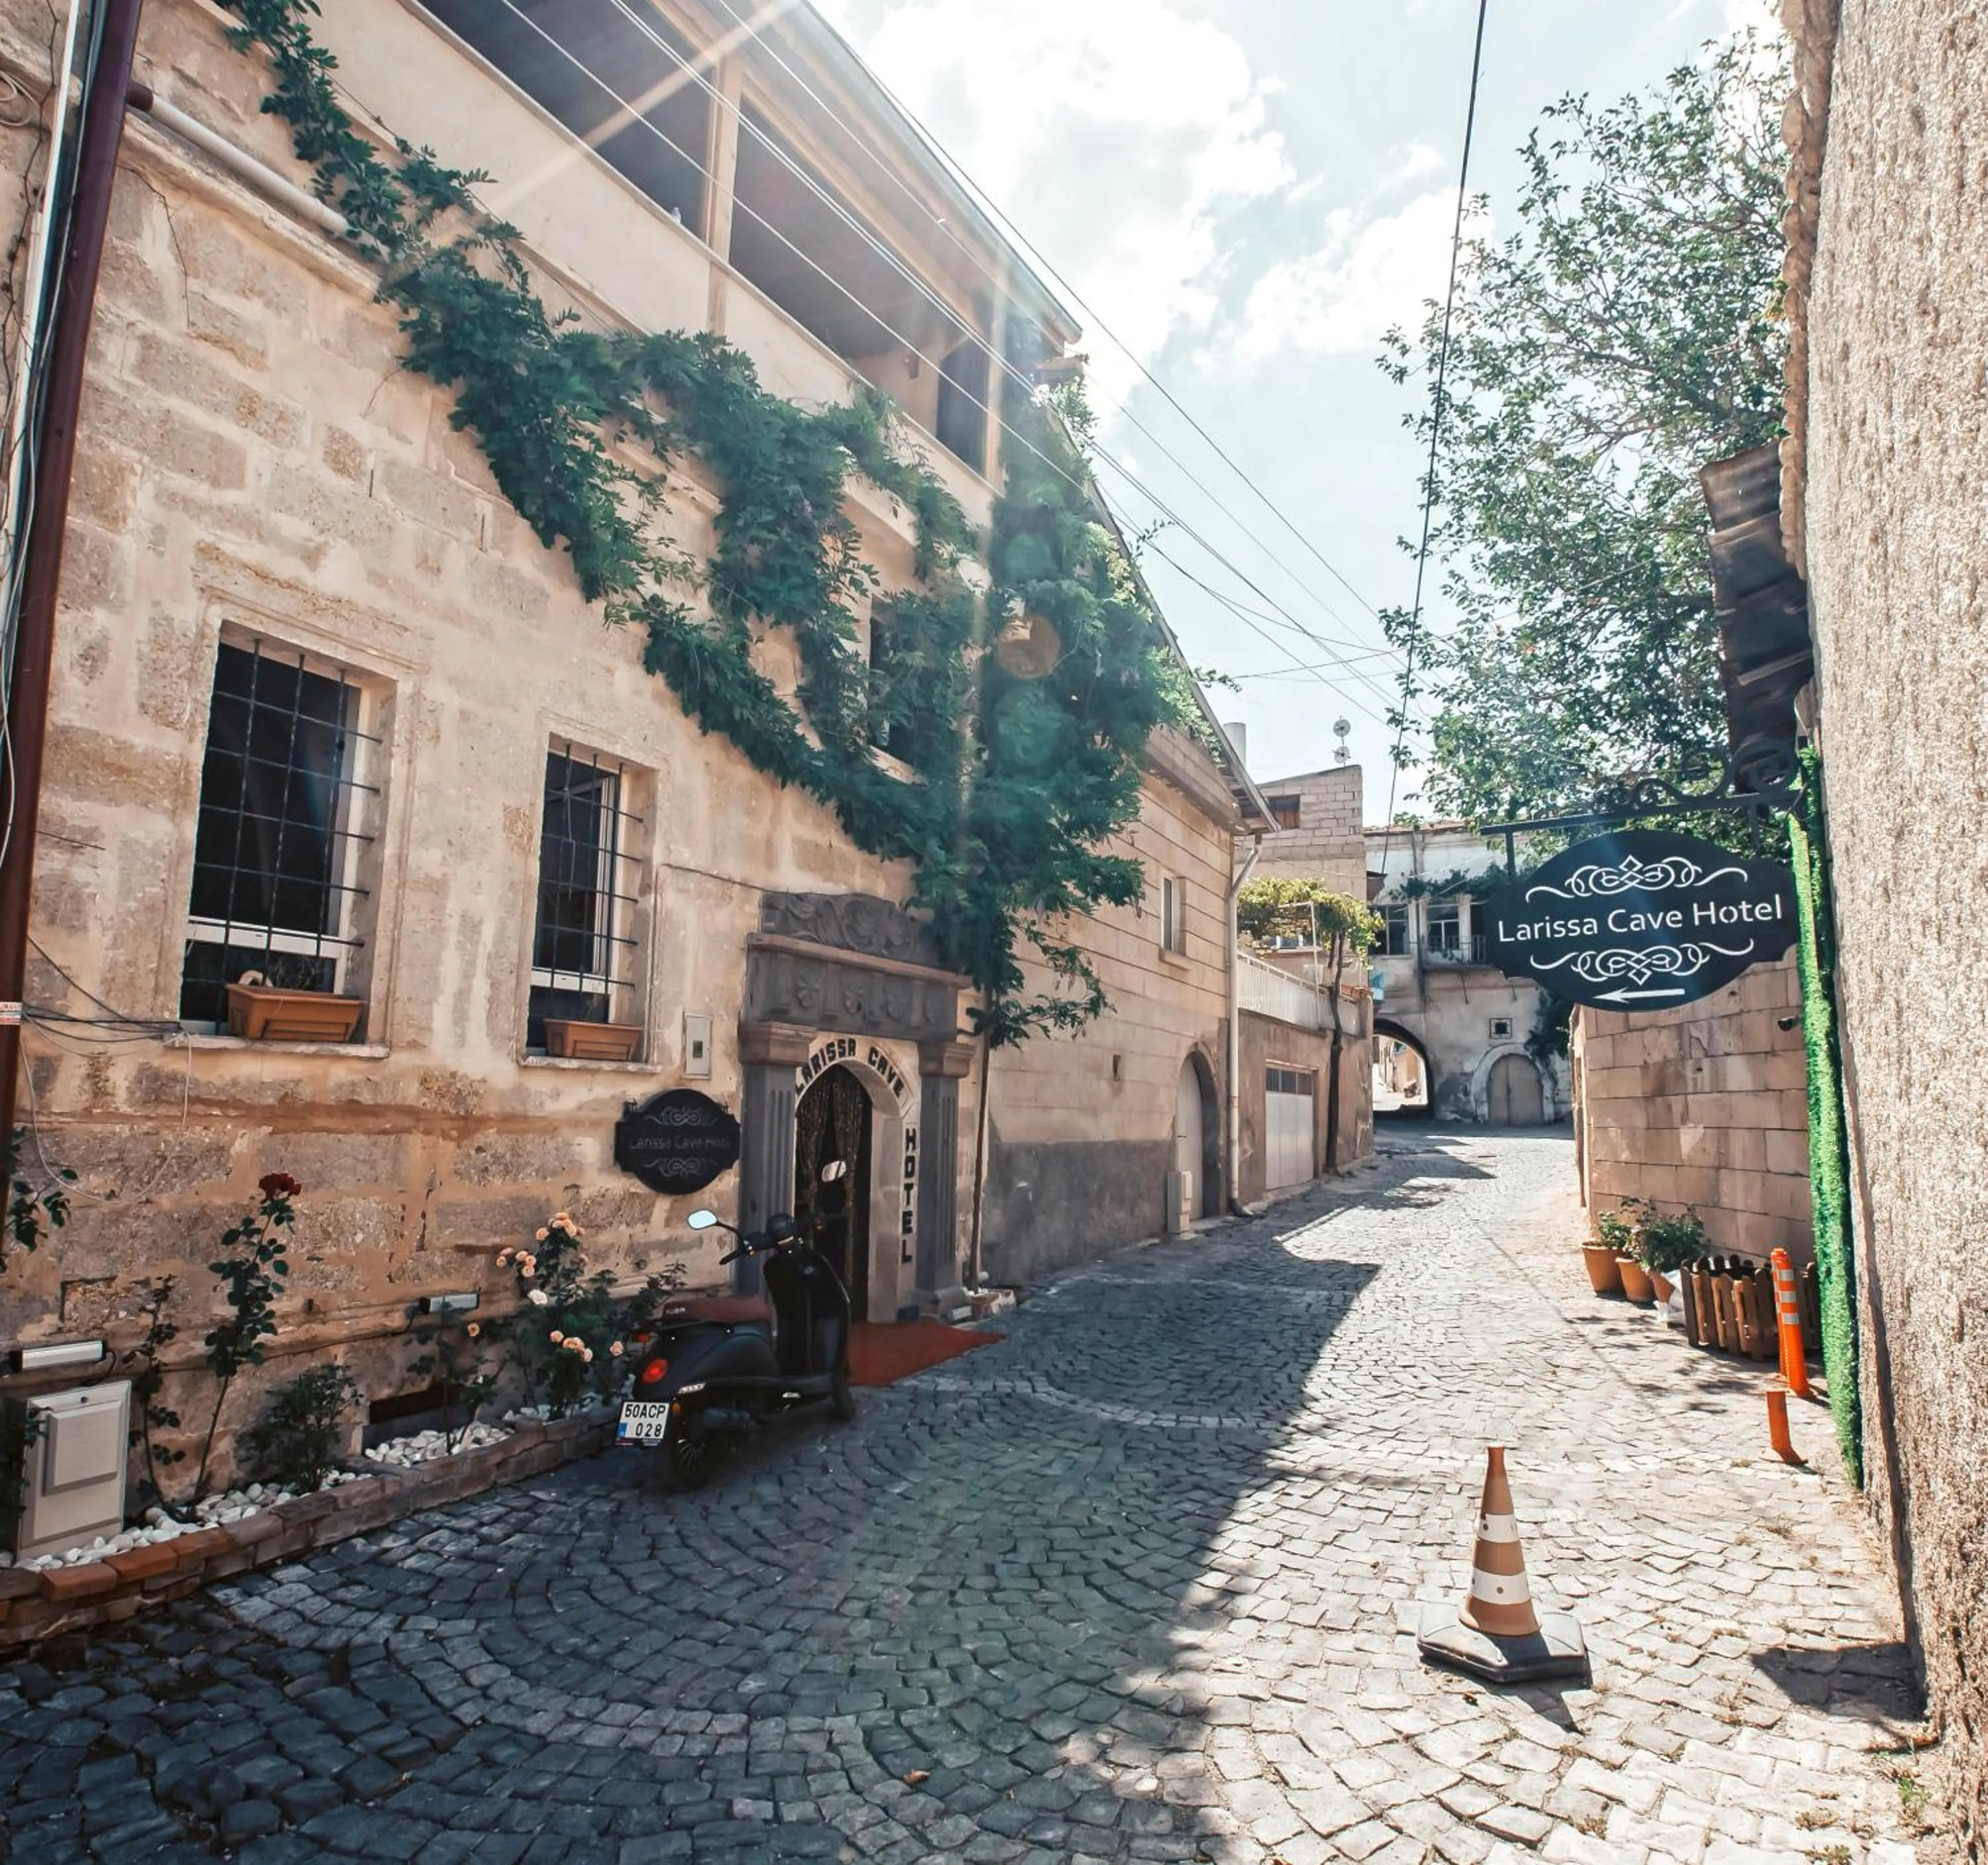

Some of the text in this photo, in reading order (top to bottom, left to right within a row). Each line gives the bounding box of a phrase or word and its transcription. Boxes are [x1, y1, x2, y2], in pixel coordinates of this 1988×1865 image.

[1498, 893, 1782, 942] Larissa Cave Hotel
[674, 1135, 702, 1149] Cave
[705, 1135, 730, 1149] Hot
[795, 1038, 916, 1264] LARISSA CAVE HOTEL
[625, 1404, 666, 1418] 50ACP
[635, 1422, 662, 1437] 028
